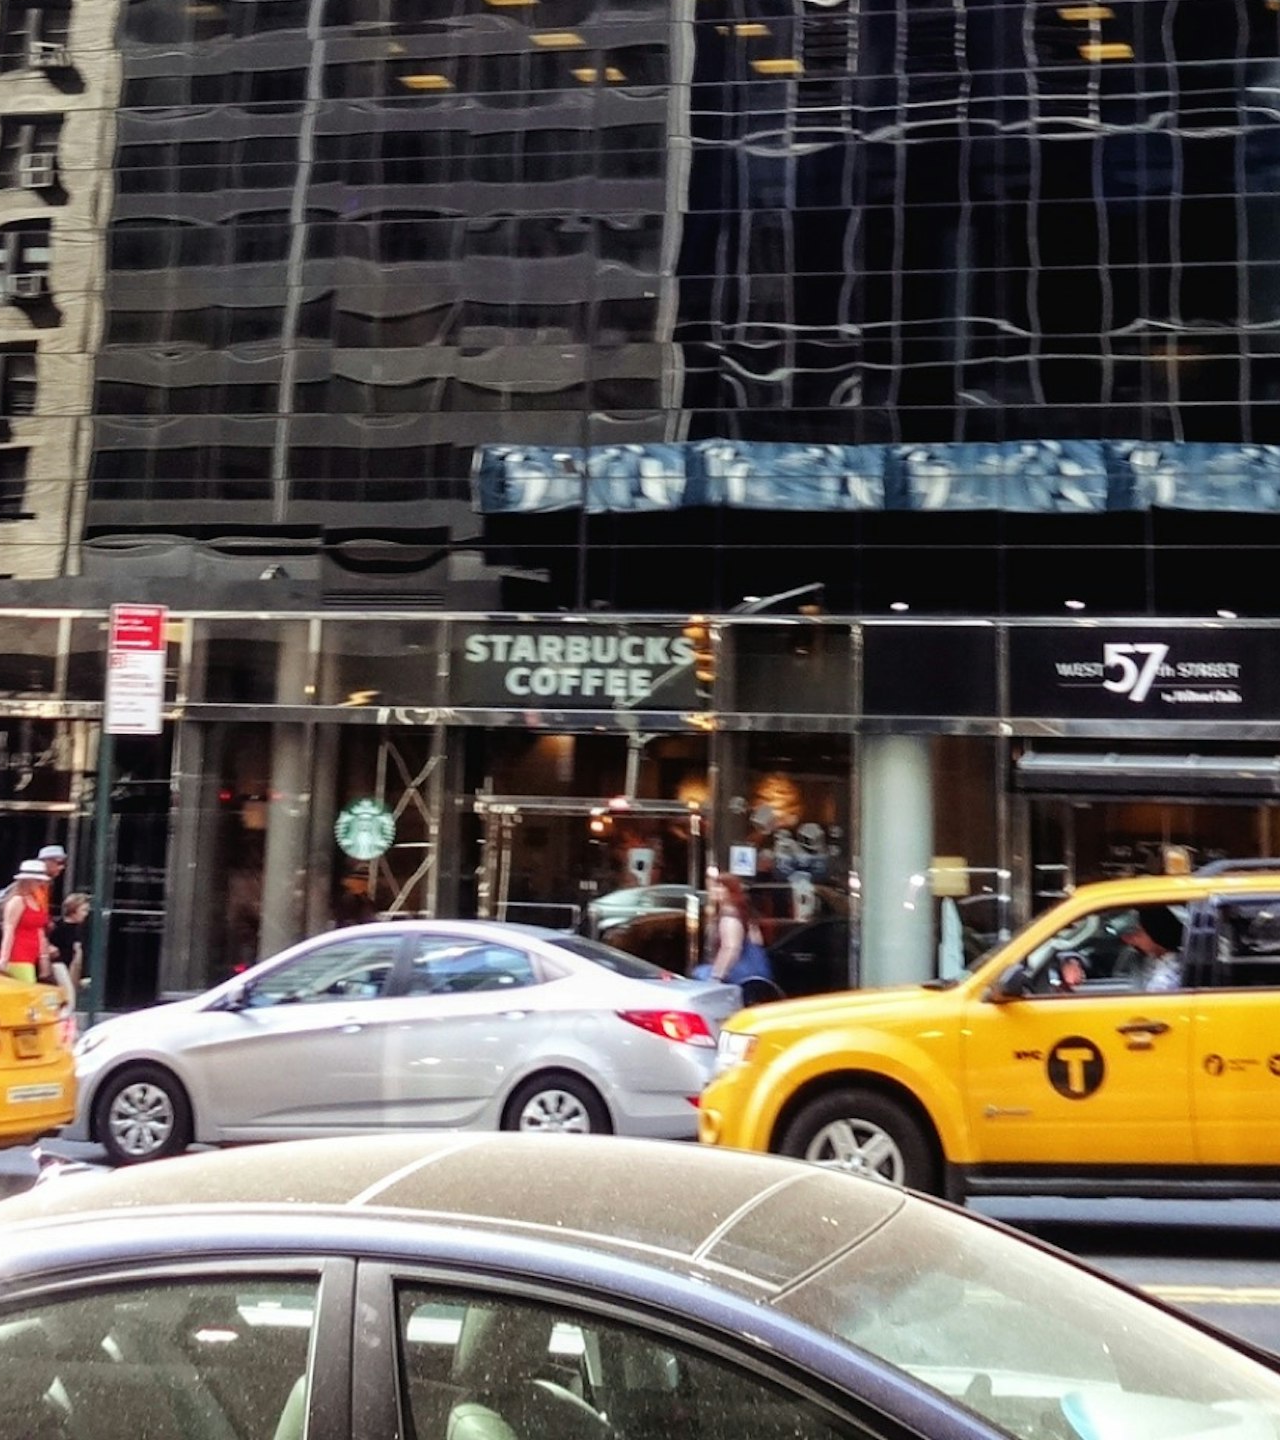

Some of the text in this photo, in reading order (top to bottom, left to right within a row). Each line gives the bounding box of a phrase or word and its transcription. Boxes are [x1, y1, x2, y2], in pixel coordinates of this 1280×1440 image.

[465, 634, 697, 665] STARBUCKS
[505, 667, 653, 697] COFFEE
[1055, 662, 1104, 678] WEST
[1176, 662, 1241, 678] STREET
